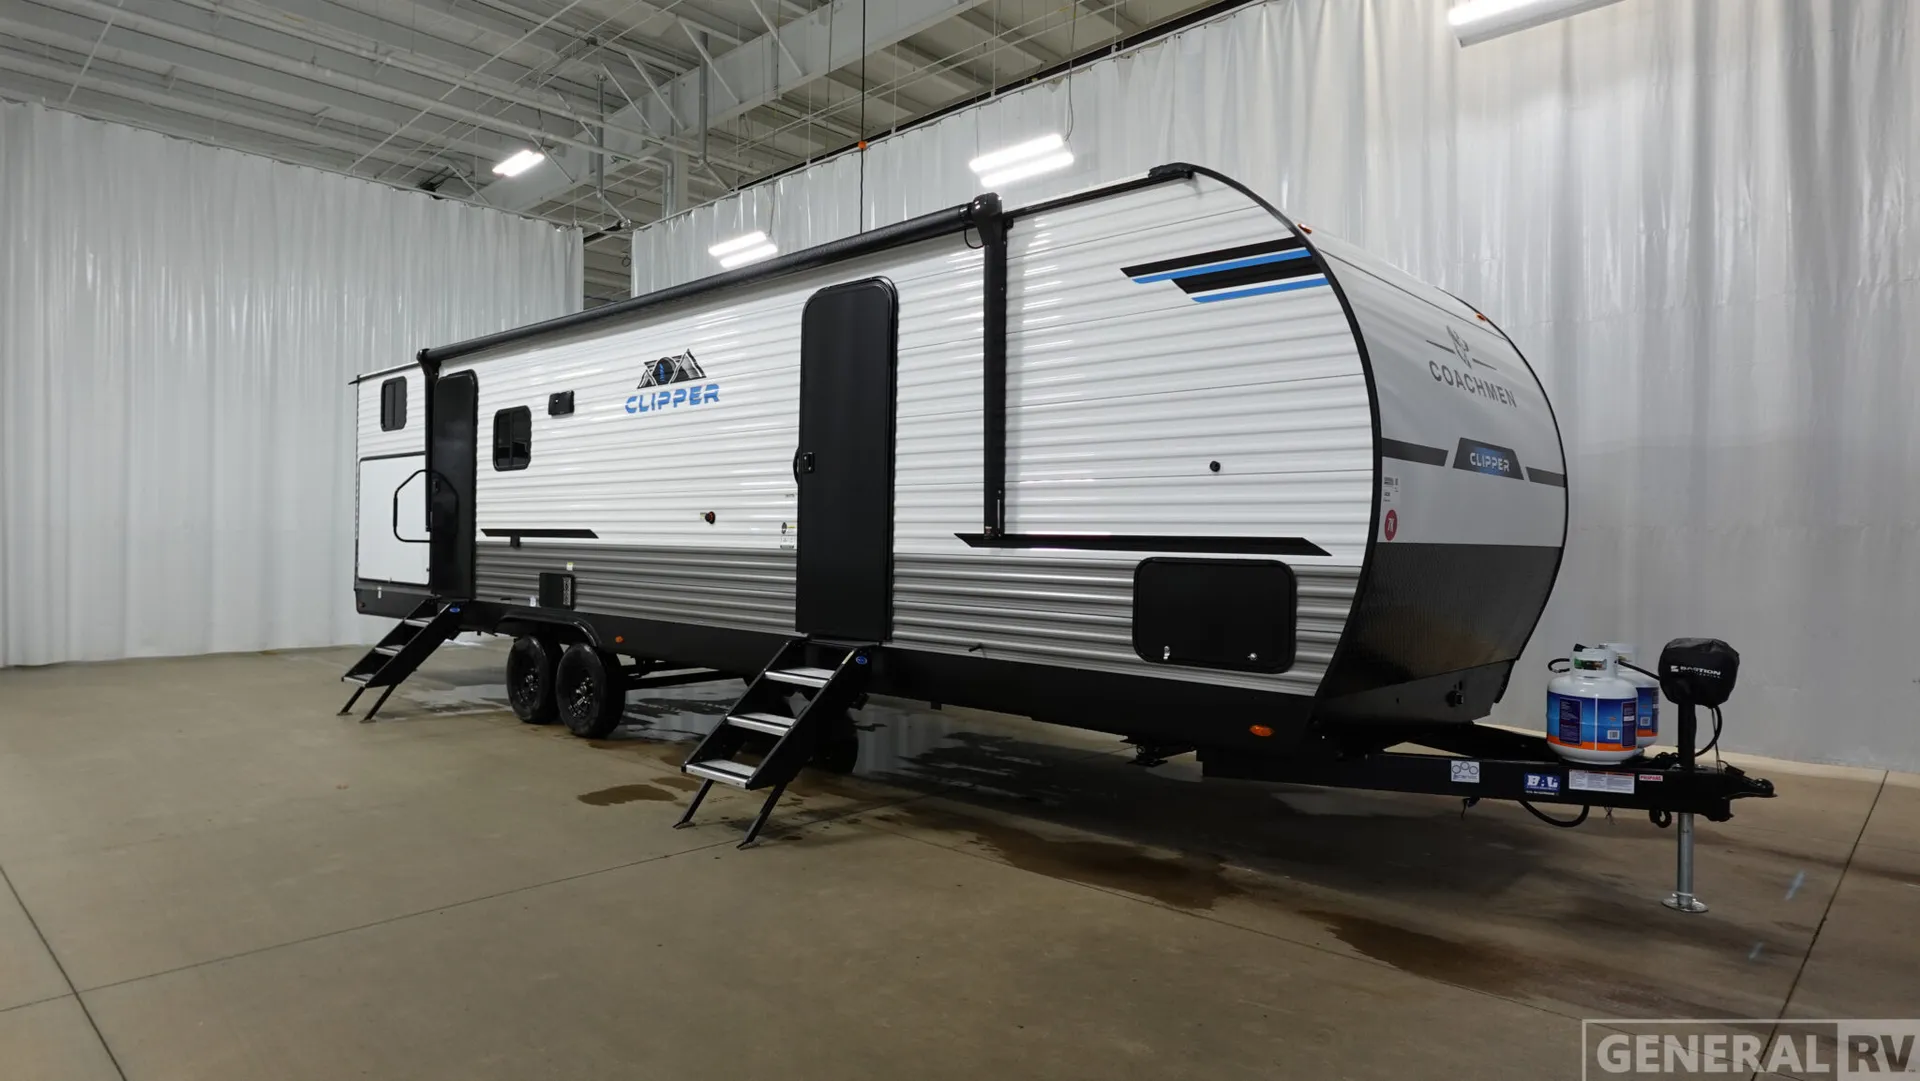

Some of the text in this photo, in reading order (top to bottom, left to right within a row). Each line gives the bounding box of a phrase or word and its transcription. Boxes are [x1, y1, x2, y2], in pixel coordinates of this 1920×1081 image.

[625, 383, 720, 414] CLIPPER
[1429, 360, 1517, 408] COACHMEN
[1469, 452, 1510, 473] CLIPPER
